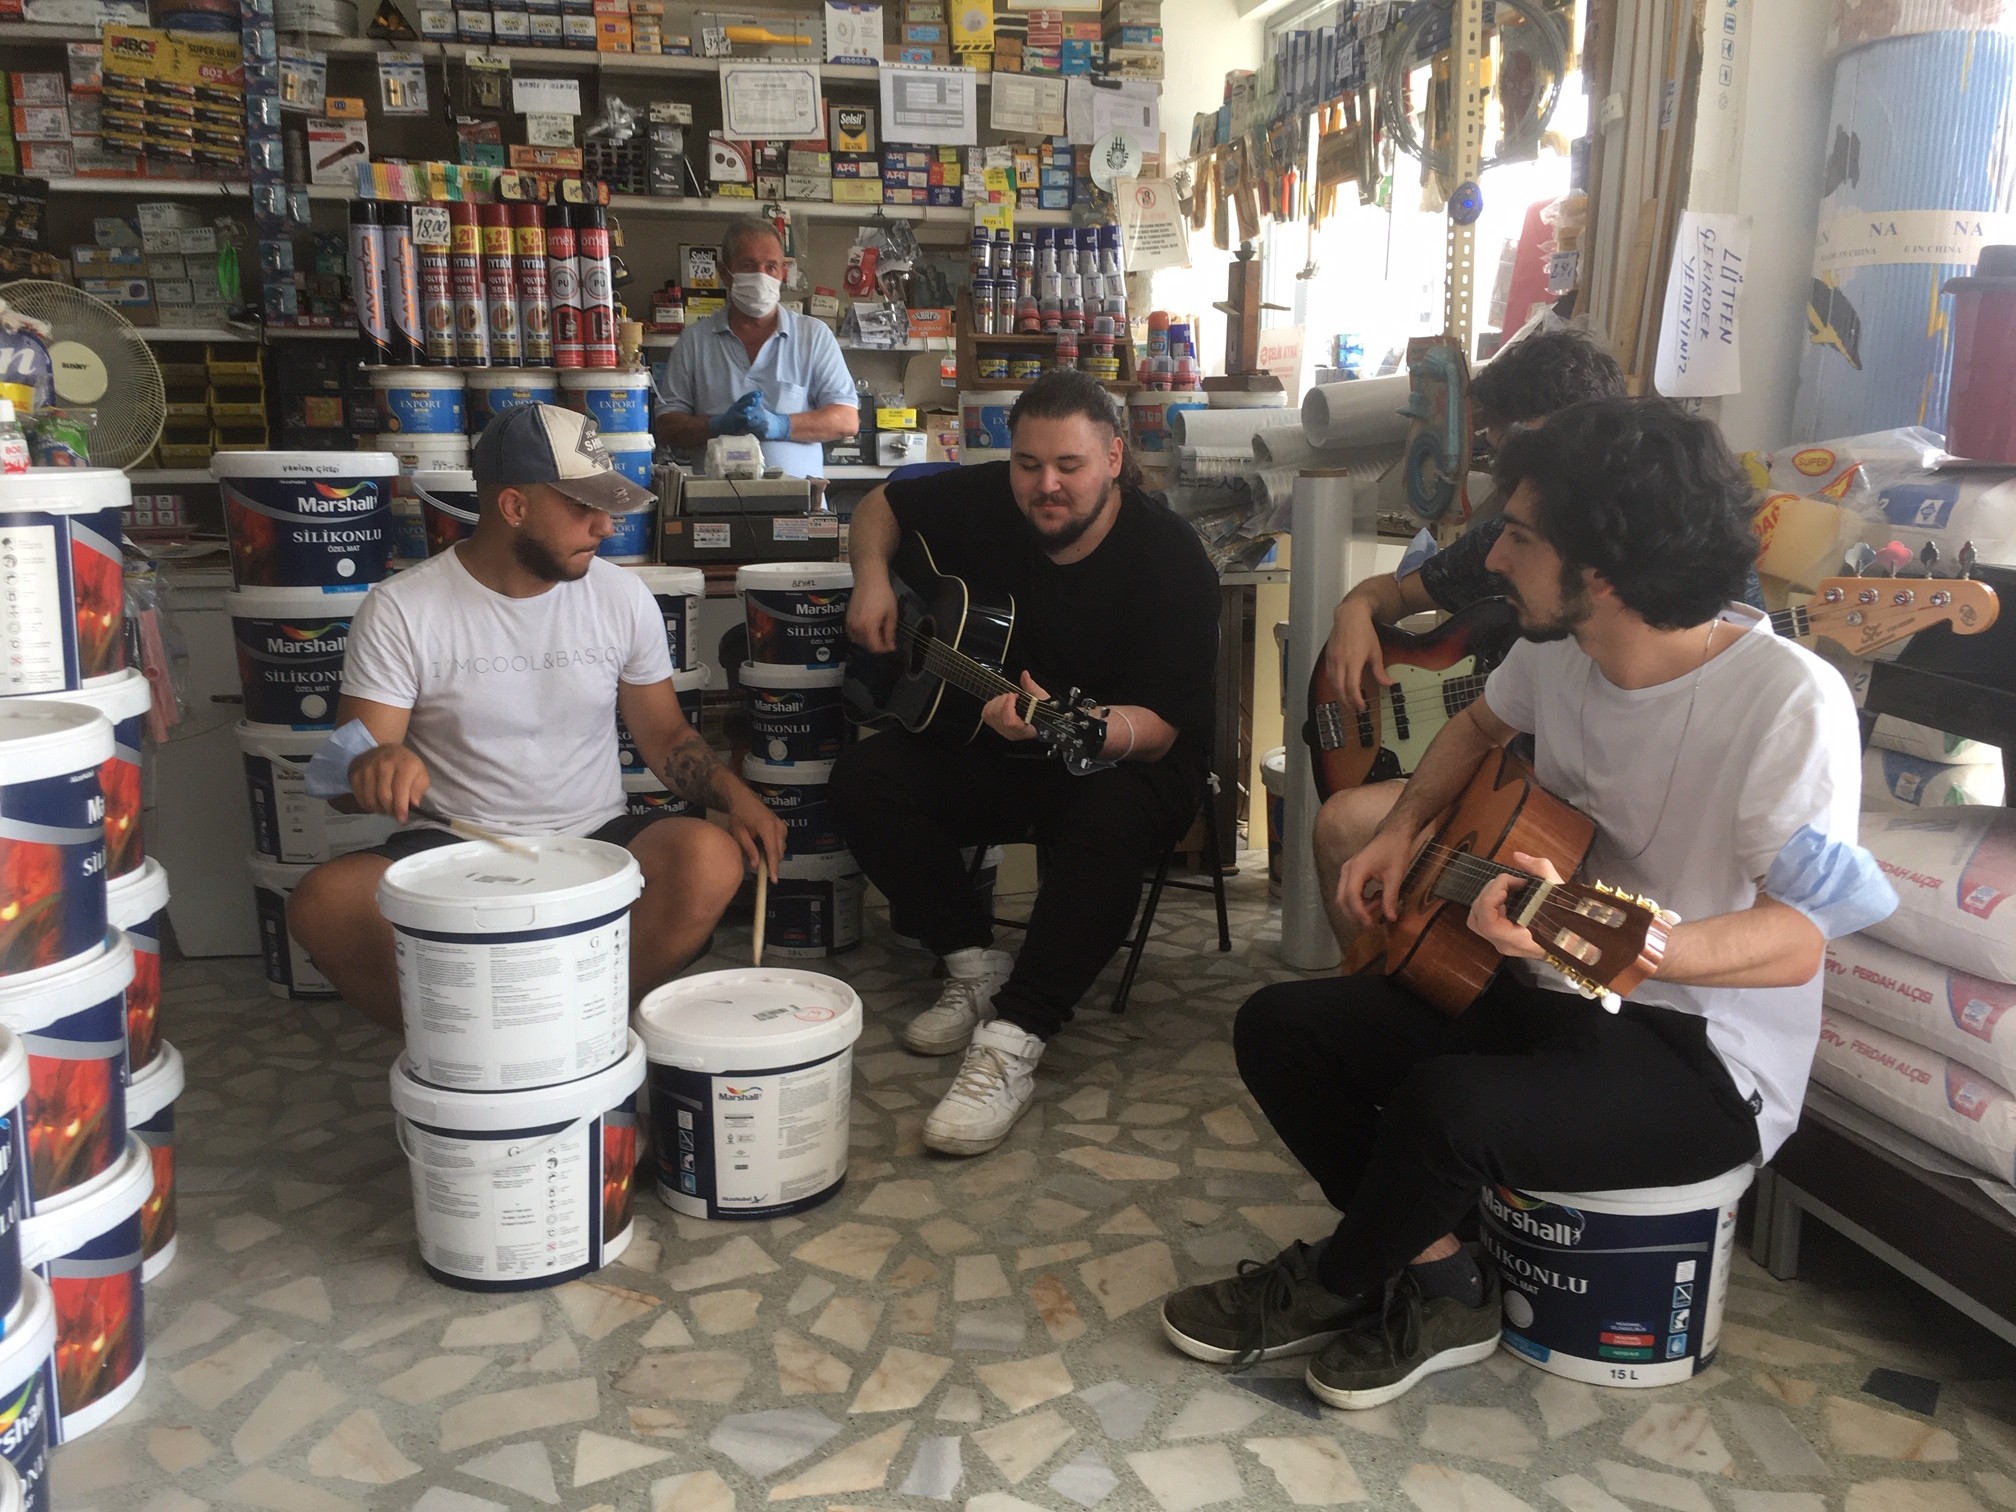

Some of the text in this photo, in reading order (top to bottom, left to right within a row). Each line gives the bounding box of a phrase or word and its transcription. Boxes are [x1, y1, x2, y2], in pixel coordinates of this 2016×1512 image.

[201, 66, 223, 78] 802
[840, 112, 863, 125] Selsil
[558, 279, 569, 287] PU
[594, 279, 605, 287] PU
[1719, 248, 1744, 345] LÜTFEN
[61, 362, 88, 371] SUNNY
[400, 400, 440, 409] EXPORT
[600, 400, 637, 409] EXPORT
[298, 495, 375, 513] Marshall
[292, 528, 382, 544] SİLİKONLU
[347, 544, 360, 552] MAT
[796, 602, 845, 616] Marshall
[787, 626, 847, 637] SİLİKONL
[267, 637, 347, 654] Marshall
[265, 669, 343, 683] SİLİKON
[754, 699, 800, 713] Marshall
[1852, 965, 1933, 1005] PERDAH ALÇISI
[1850, 1039, 1932, 1085] PERDAH ALÇISI
[718, 1092, 760, 1101] Marshall
[1481, 1185, 1572, 1246] Marshall
[1610, 1369, 1639, 1380] 15 L
